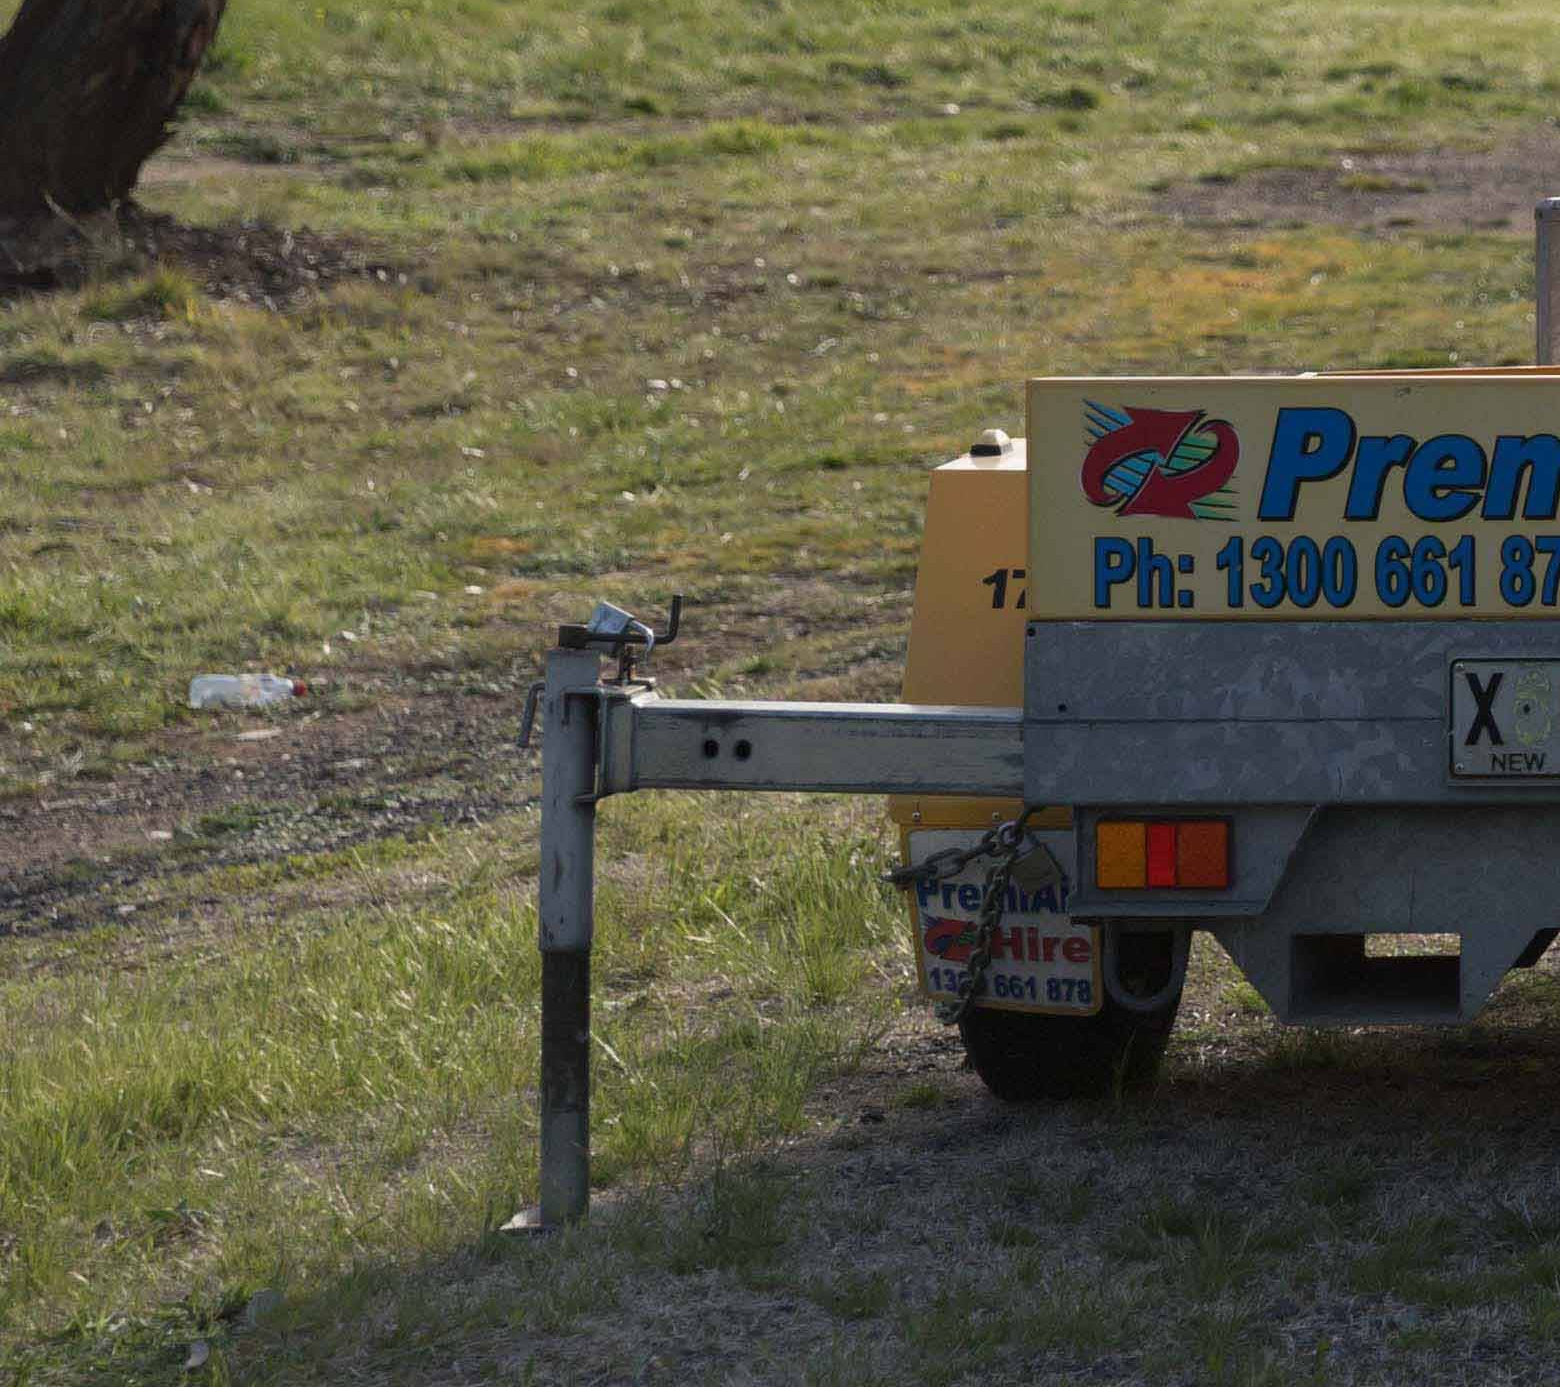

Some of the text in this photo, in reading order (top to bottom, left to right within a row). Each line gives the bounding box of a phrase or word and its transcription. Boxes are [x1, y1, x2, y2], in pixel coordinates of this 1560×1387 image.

[1093, 535, 1196, 609] Ph:
[1216, 535, 1359, 609] 1300
[1374, 534, 1477, 609] 661
[1464, 671, 1505, 747] X
[1491, 752, 1548, 773] NEW
[990, 926, 1090, 963] Hire
[929, 966, 1091, 1004] 13 661 878
